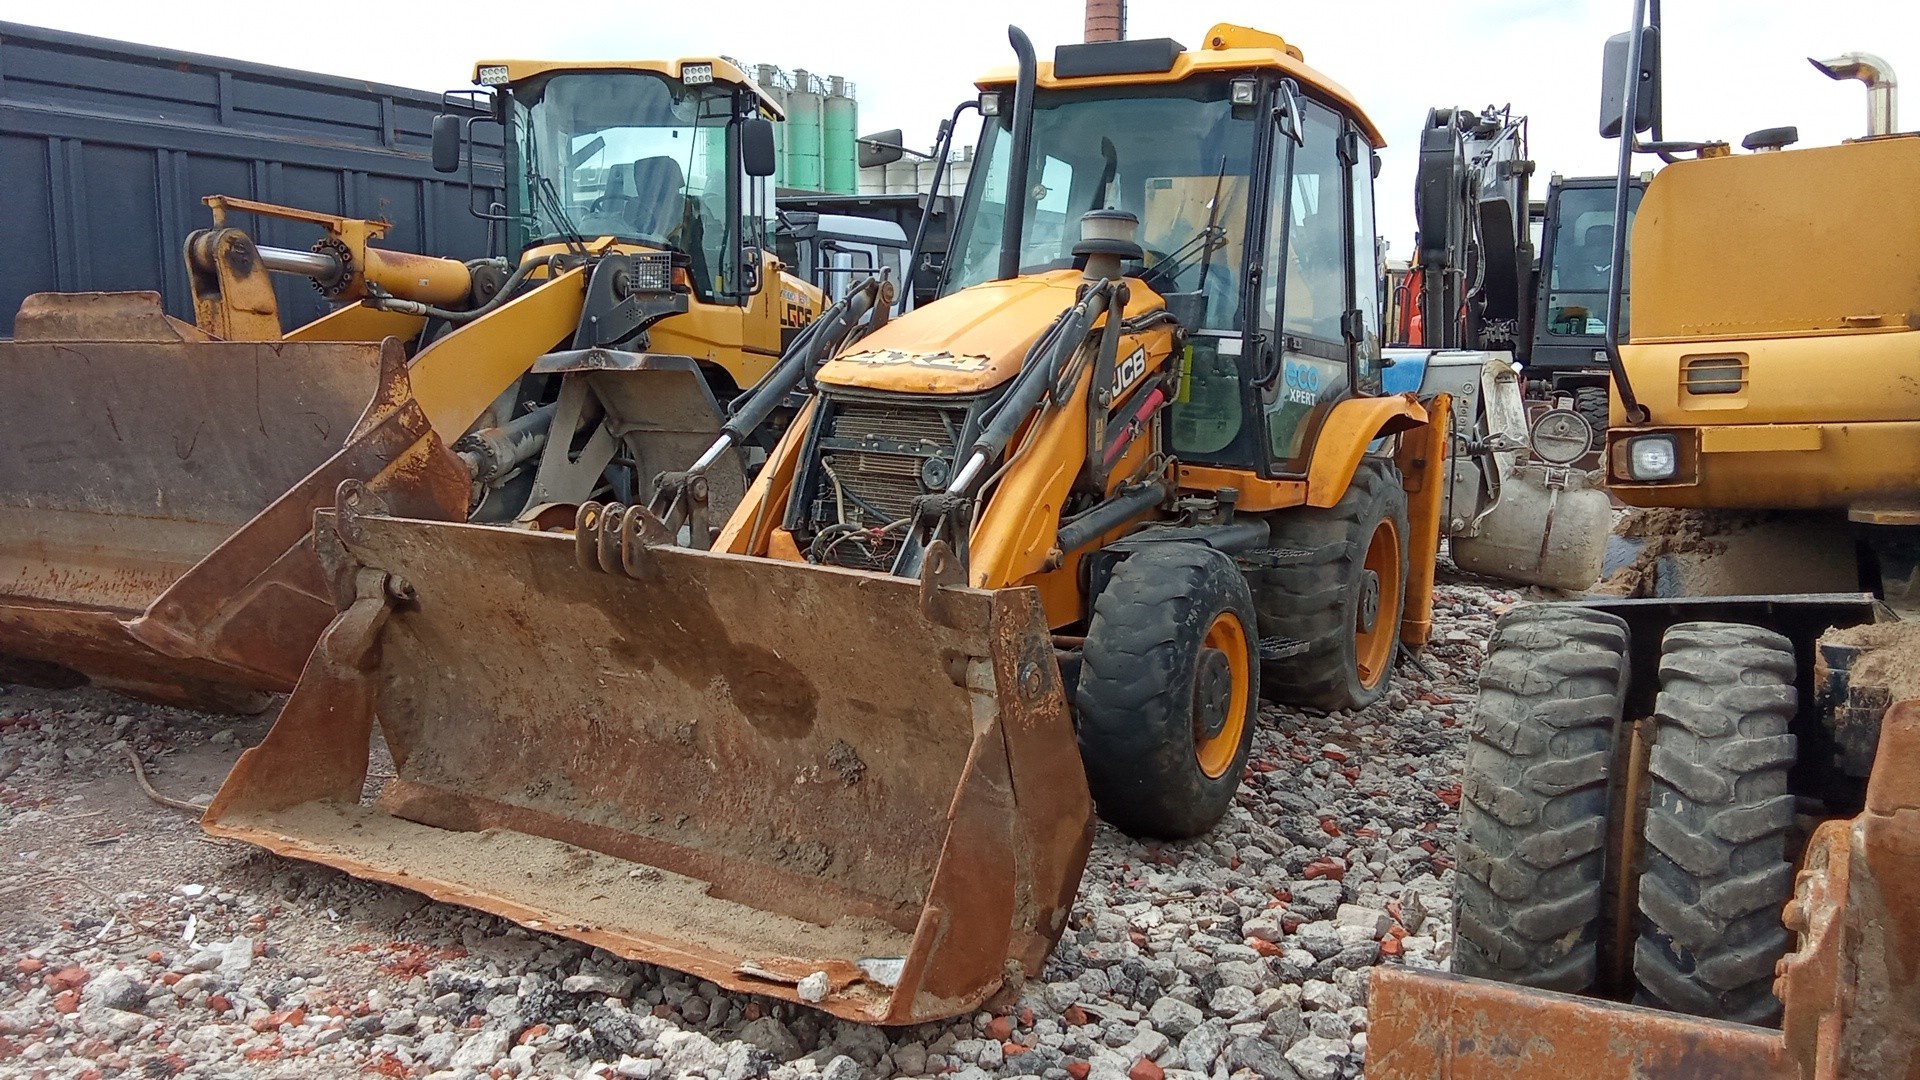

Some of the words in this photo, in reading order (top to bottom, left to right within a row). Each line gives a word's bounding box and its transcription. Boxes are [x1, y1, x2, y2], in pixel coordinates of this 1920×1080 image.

[1112, 347, 1145, 398] JCB
[1285, 361, 1318, 391] eco
[1290, 388, 1315, 407] XPERT
